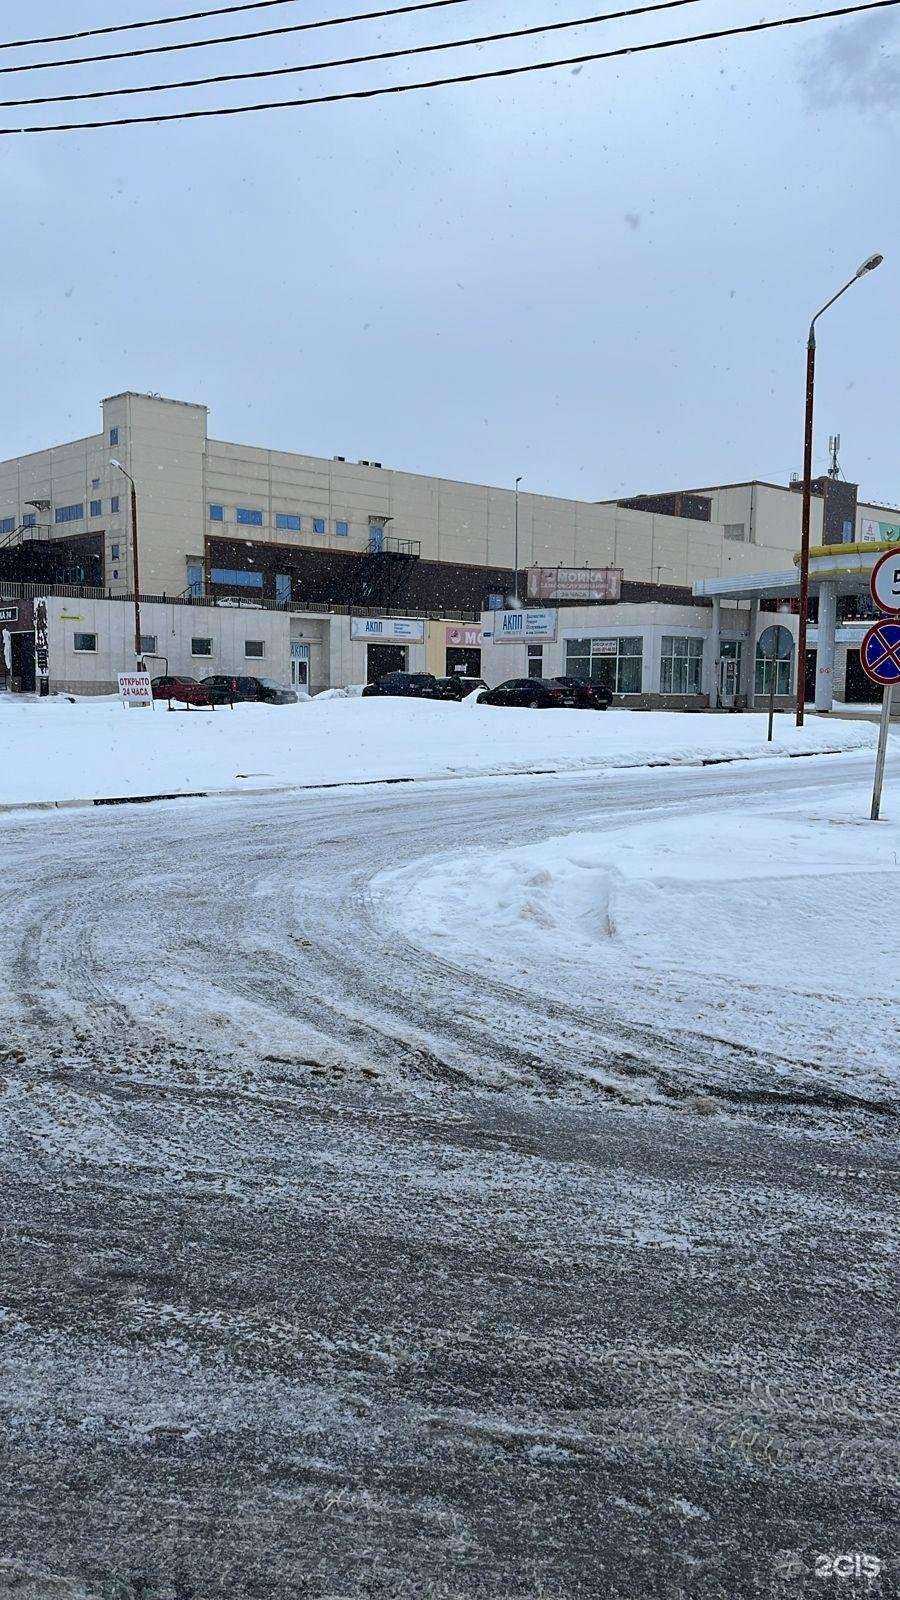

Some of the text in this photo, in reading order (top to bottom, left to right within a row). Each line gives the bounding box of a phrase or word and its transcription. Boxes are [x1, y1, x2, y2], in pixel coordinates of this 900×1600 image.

[557, 572, 603, 583] МОЙКА
[365, 620, 383, 633] АКПП
[502, 614, 523, 630] АКПП
[119, 676, 150, 687] ОТКРЫТО
[122, 687, 149, 697] 24 ЧАСА
